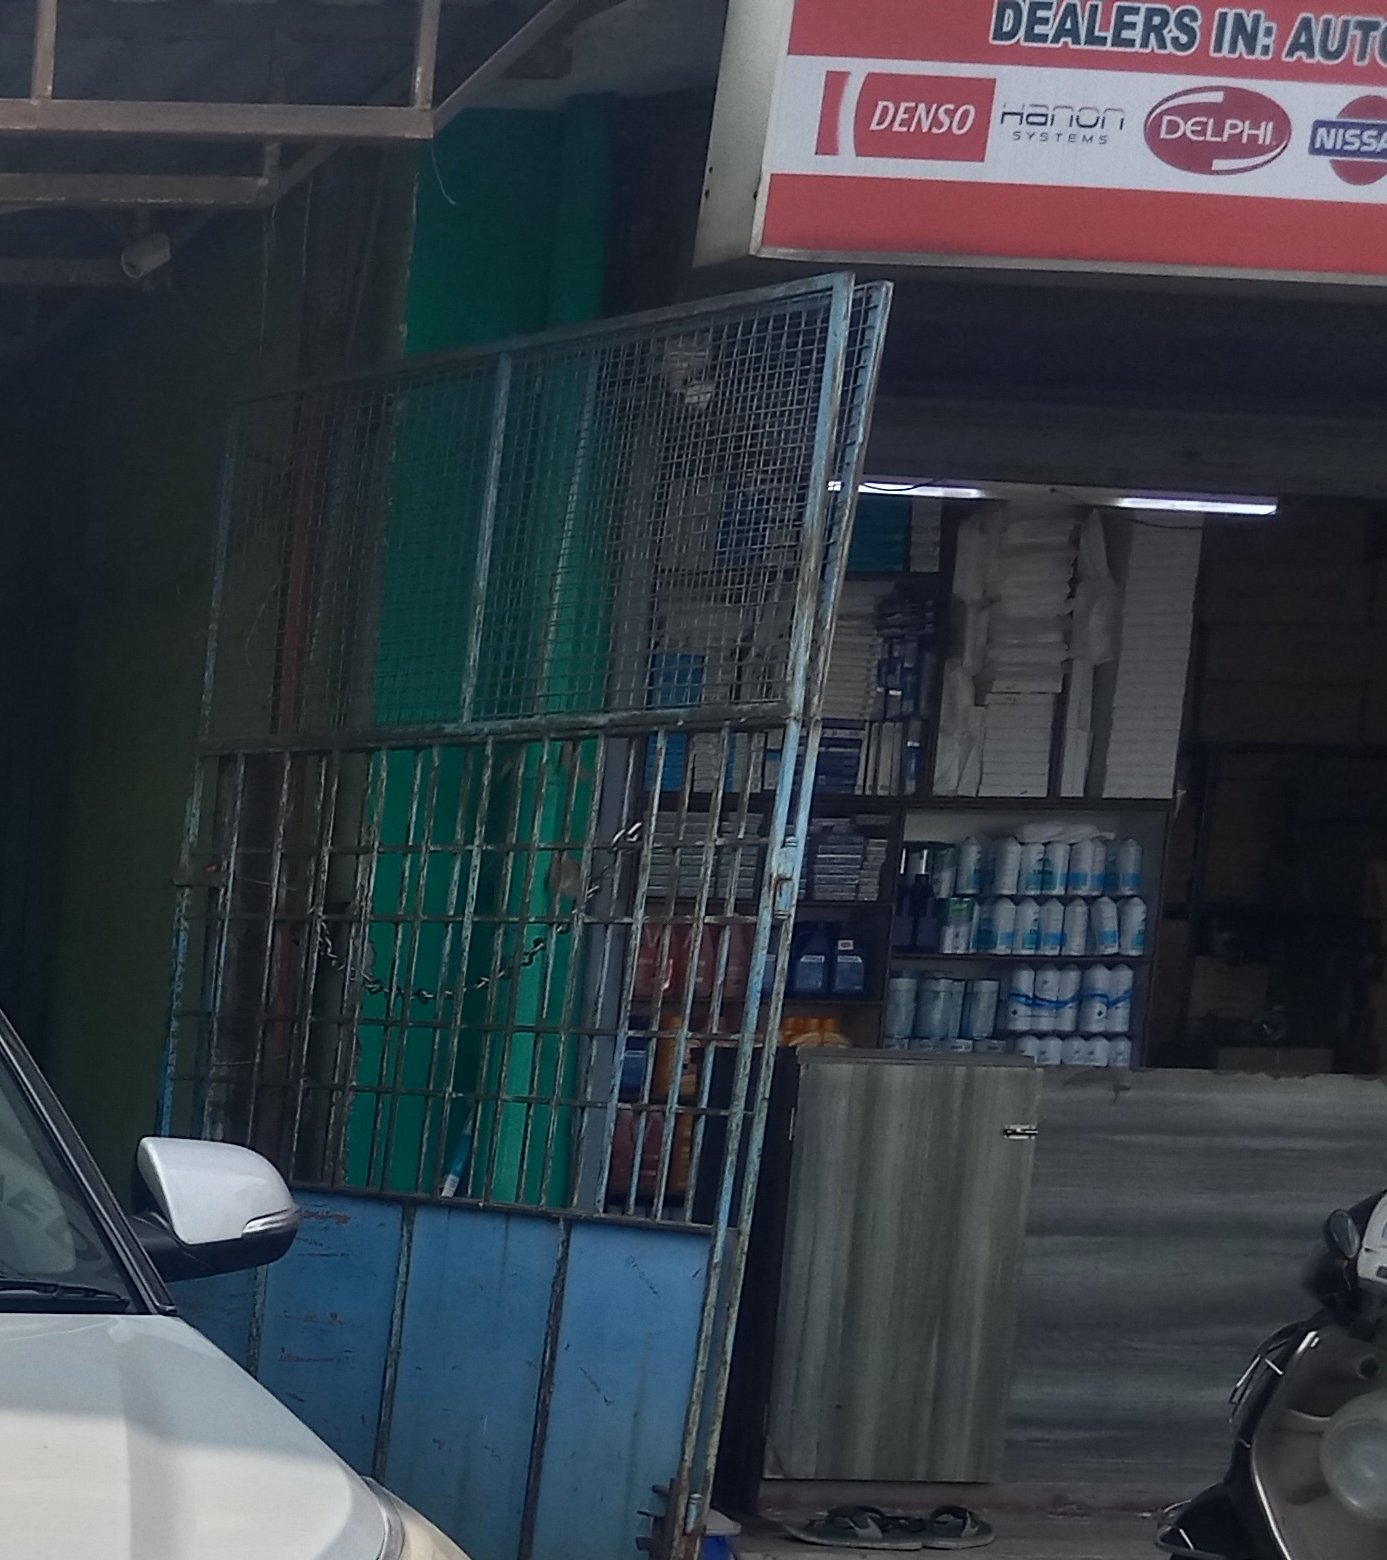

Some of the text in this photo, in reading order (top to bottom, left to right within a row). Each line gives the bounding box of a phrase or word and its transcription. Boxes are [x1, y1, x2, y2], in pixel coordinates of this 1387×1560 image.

[990, 0, 1200, 54] DEALERS
[1211, 10, 1276, 59] IN:
[870, 100, 975, 136] DENSO
[1159, 115, 1274, 145] DELPHI
[1012, 131, 1108, 145] SYSTEMS
